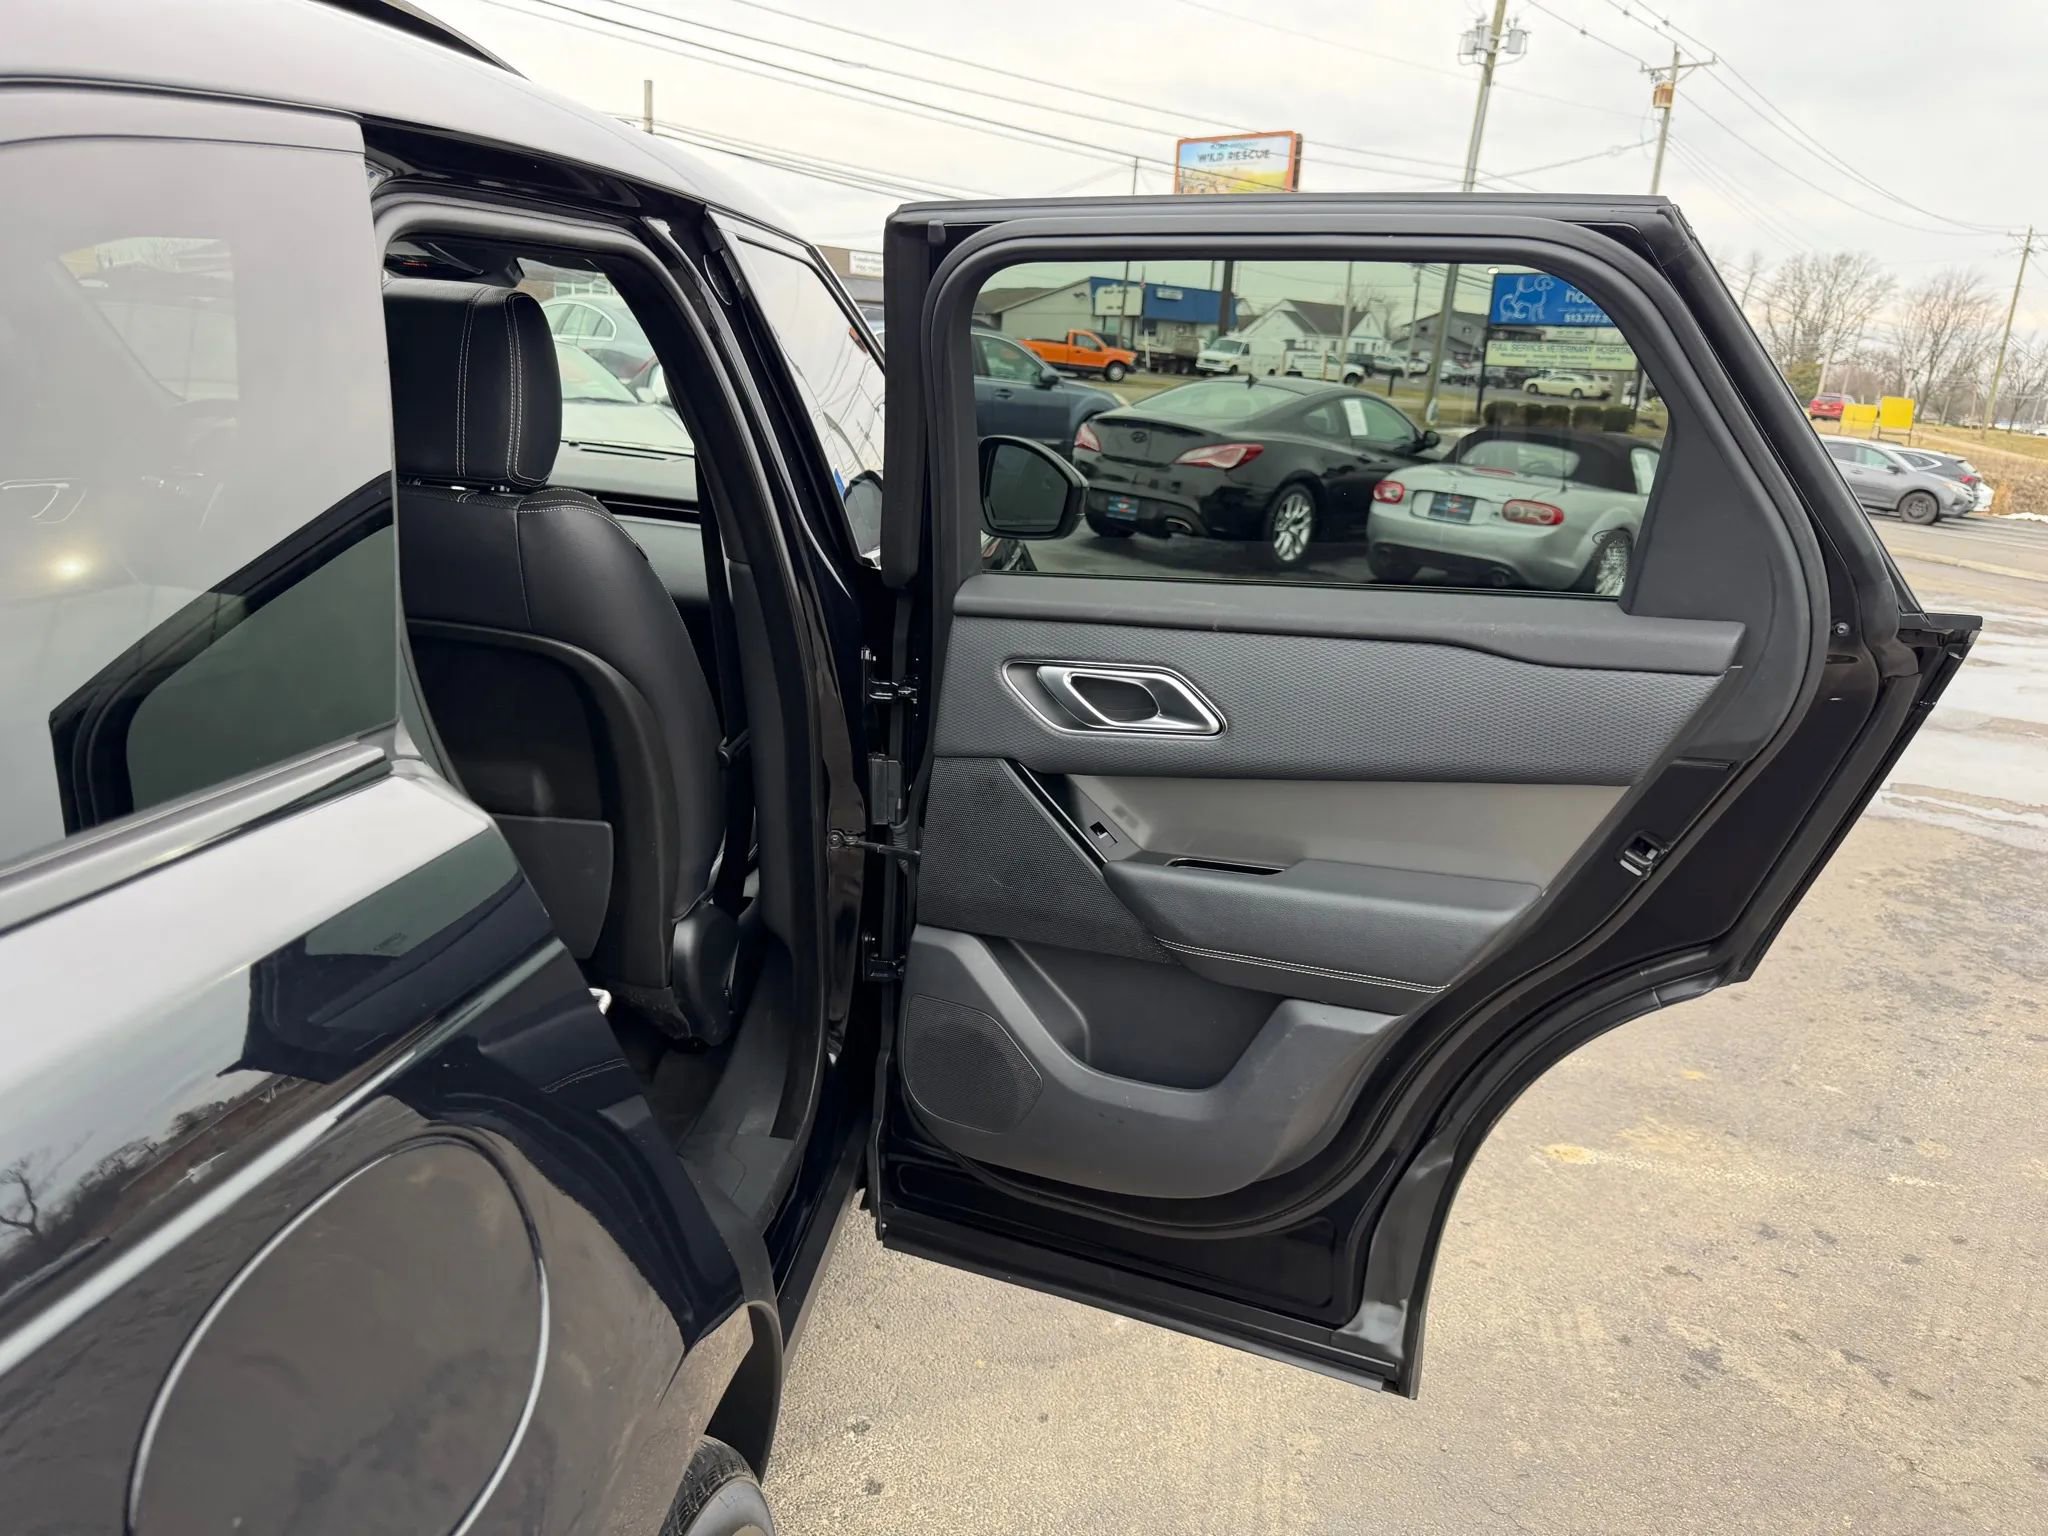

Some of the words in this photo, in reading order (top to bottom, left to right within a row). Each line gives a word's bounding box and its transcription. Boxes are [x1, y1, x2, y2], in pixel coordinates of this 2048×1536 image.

[1197, 152, 1224, 163] WILD
[1228, 149, 1270, 161] RESCUE
[1491, 343, 1508, 352] FULL
[1511, 343, 1544, 353] SERVICE
[1546, 344, 1592, 354] VETERINARY
